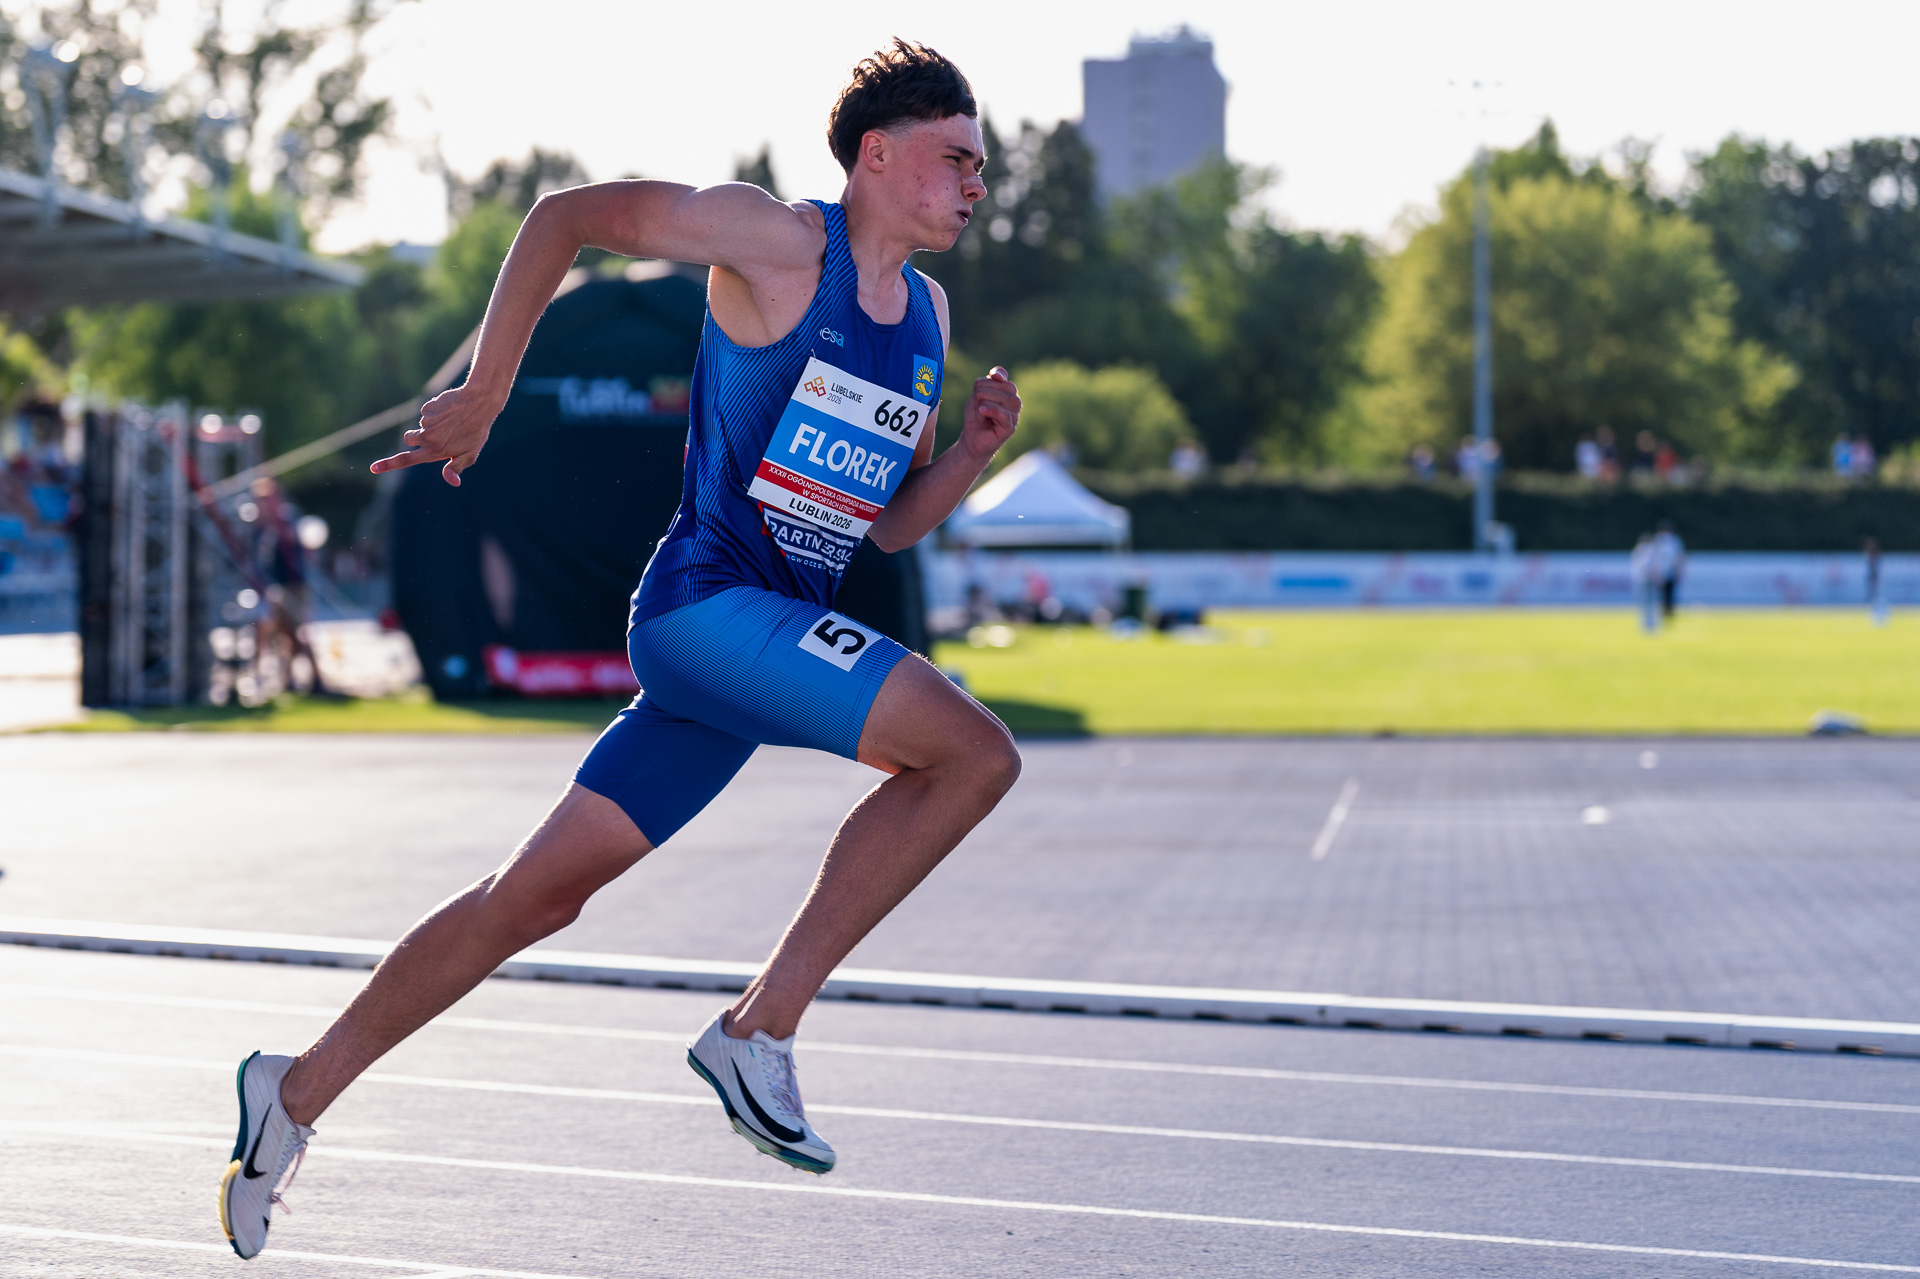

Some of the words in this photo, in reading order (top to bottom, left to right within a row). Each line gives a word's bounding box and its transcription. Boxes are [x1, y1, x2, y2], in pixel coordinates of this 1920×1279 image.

[820, 327, 845, 348] esa
[827, 393, 842, 405] 2026
[831, 383, 864, 404] LUBELSKIE
[874, 399, 919, 438] 662
[788, 422, 898, 492] FLOREK
[768, 466, 788, 479] XXXII
[787, 474, 836, 499] OGÓLNOPOLSKA
[789, 497, 832, 523] LUBLIN
[831, 514, 853, 530] 2026
[810, 492, 840, 511] SPORTACH
[813, 618, 867, 655] 5
